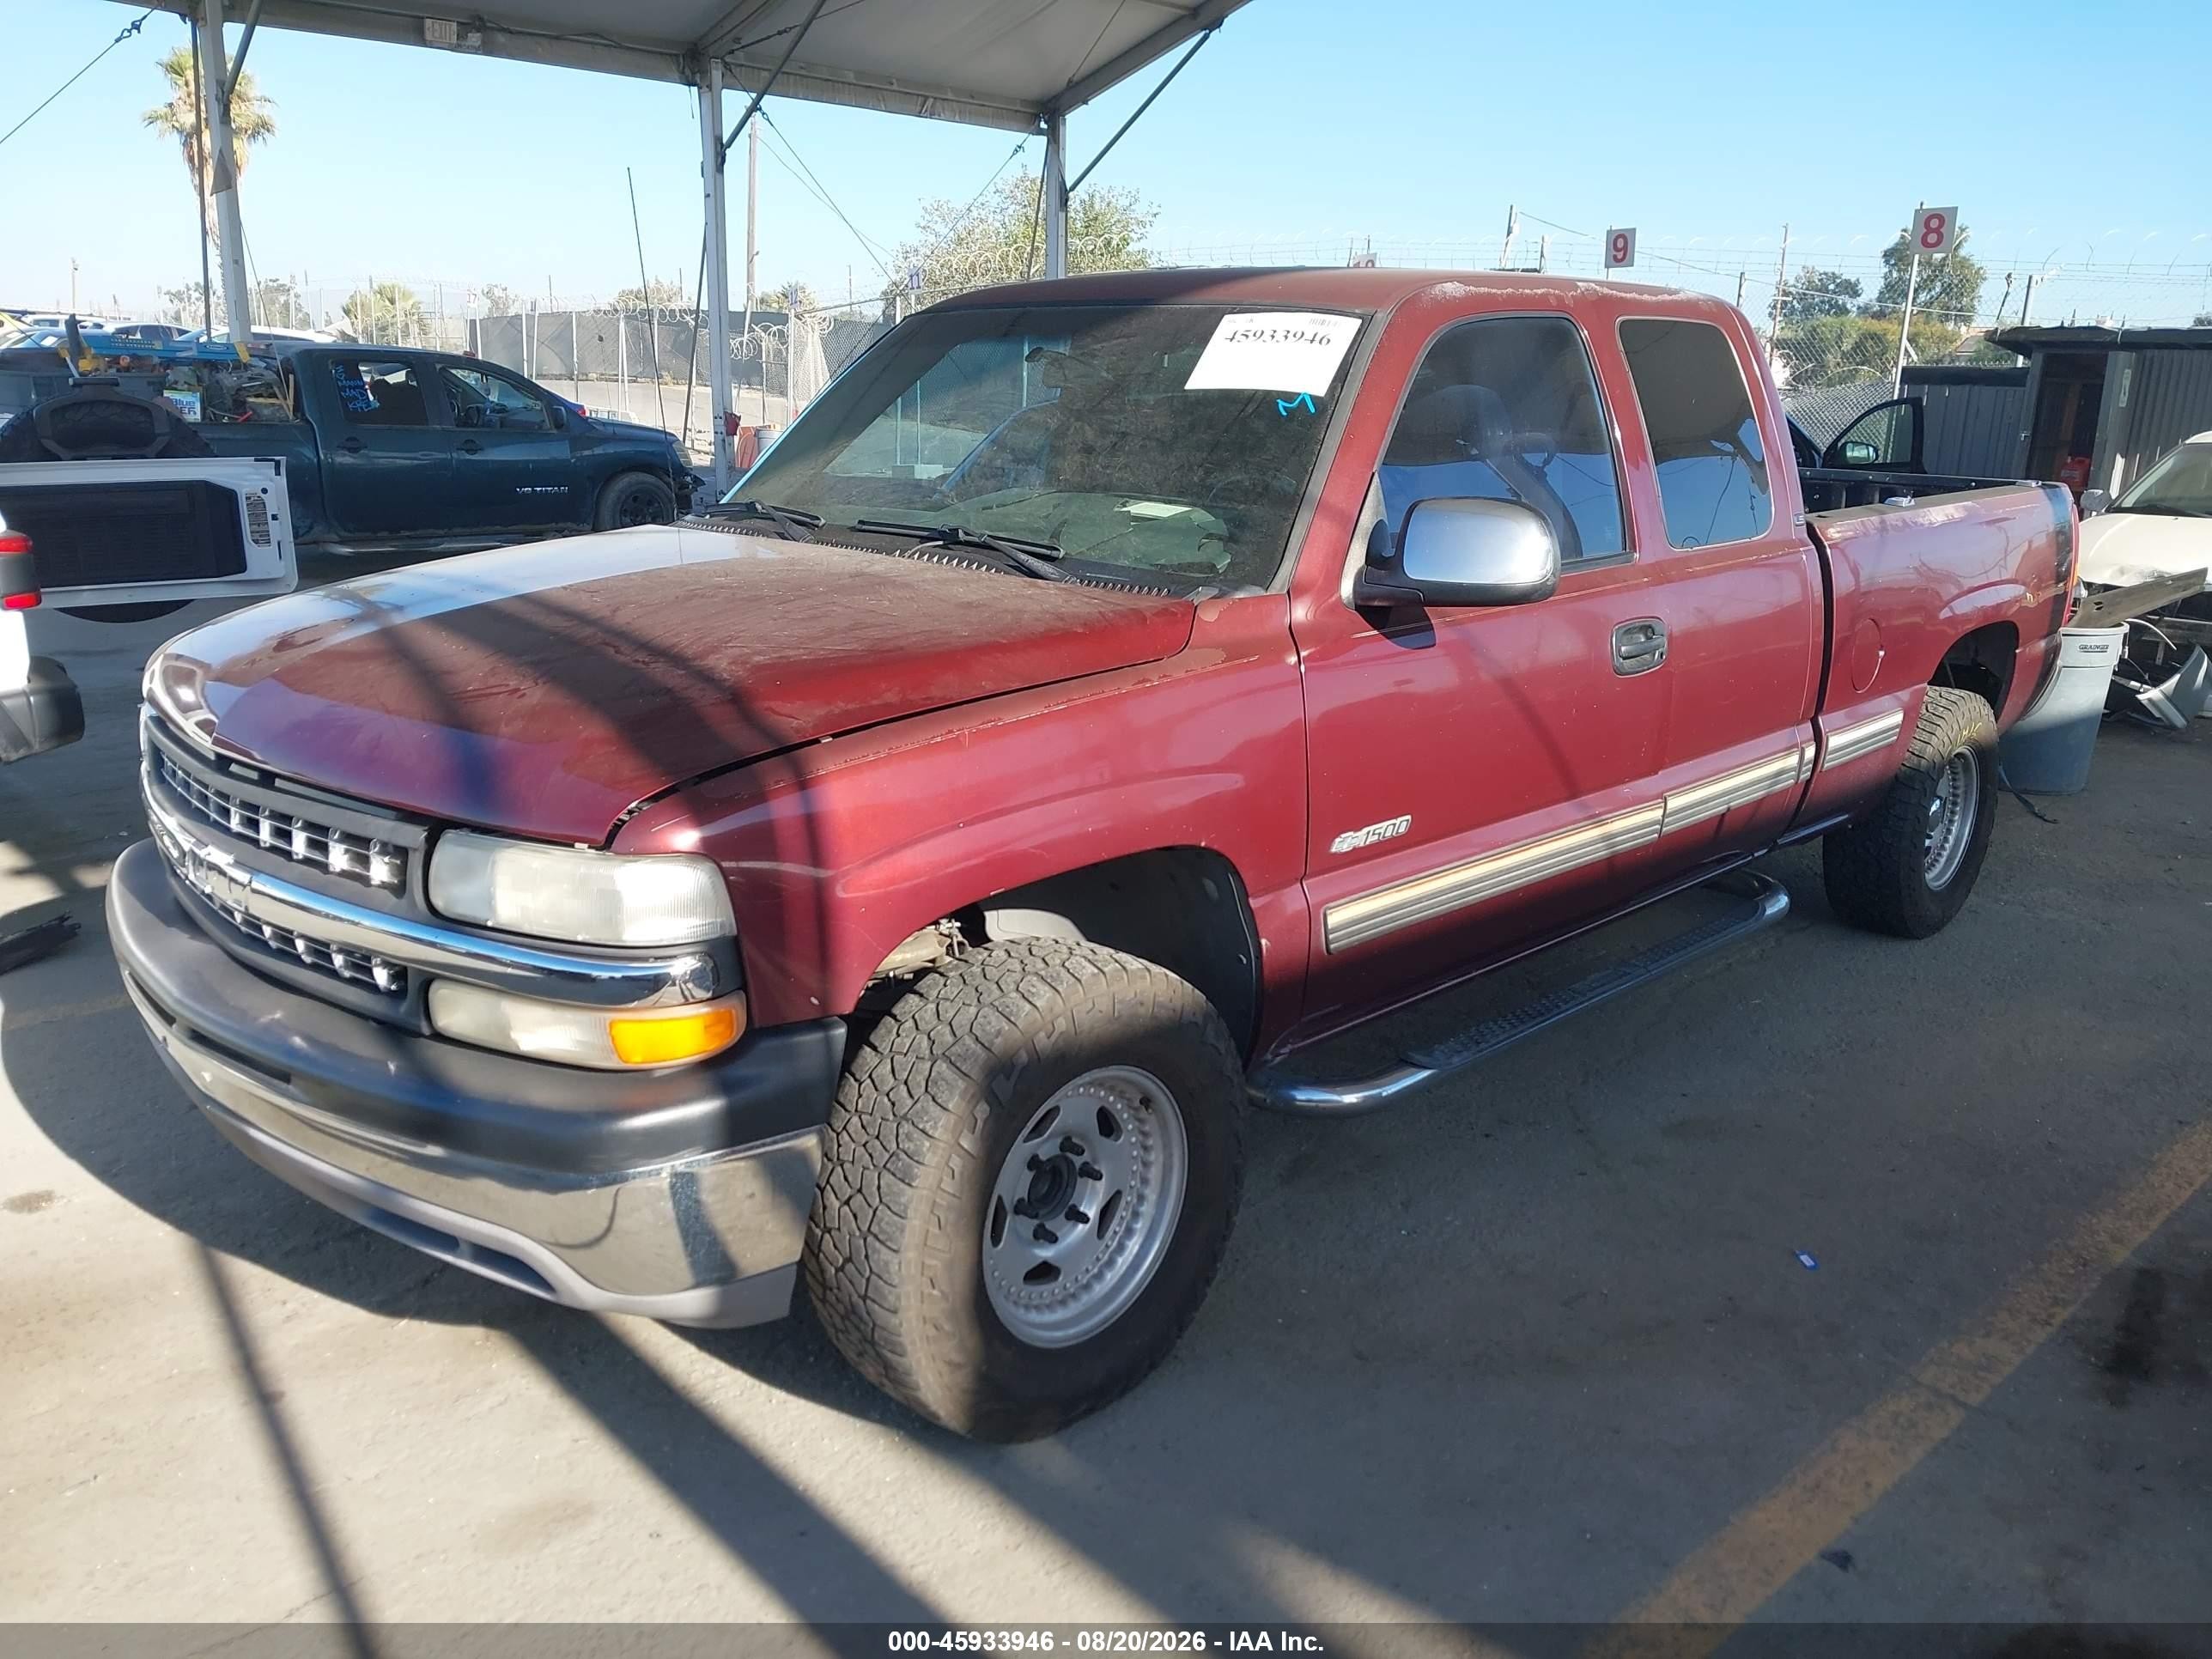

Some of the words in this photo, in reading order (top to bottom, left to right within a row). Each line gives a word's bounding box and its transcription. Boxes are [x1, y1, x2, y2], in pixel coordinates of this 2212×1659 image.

[431, 20, 453, 42] EXIT
[1921, 213, 1945, 248] 8
[1613, 233, 1629, 264] 9
[466, 293, 477, 304] 17
[1224, 329, 1331, 346] 45933946
[1276, 392, 1316, 416] M
[1364, 816, 1411, 845] 1500
